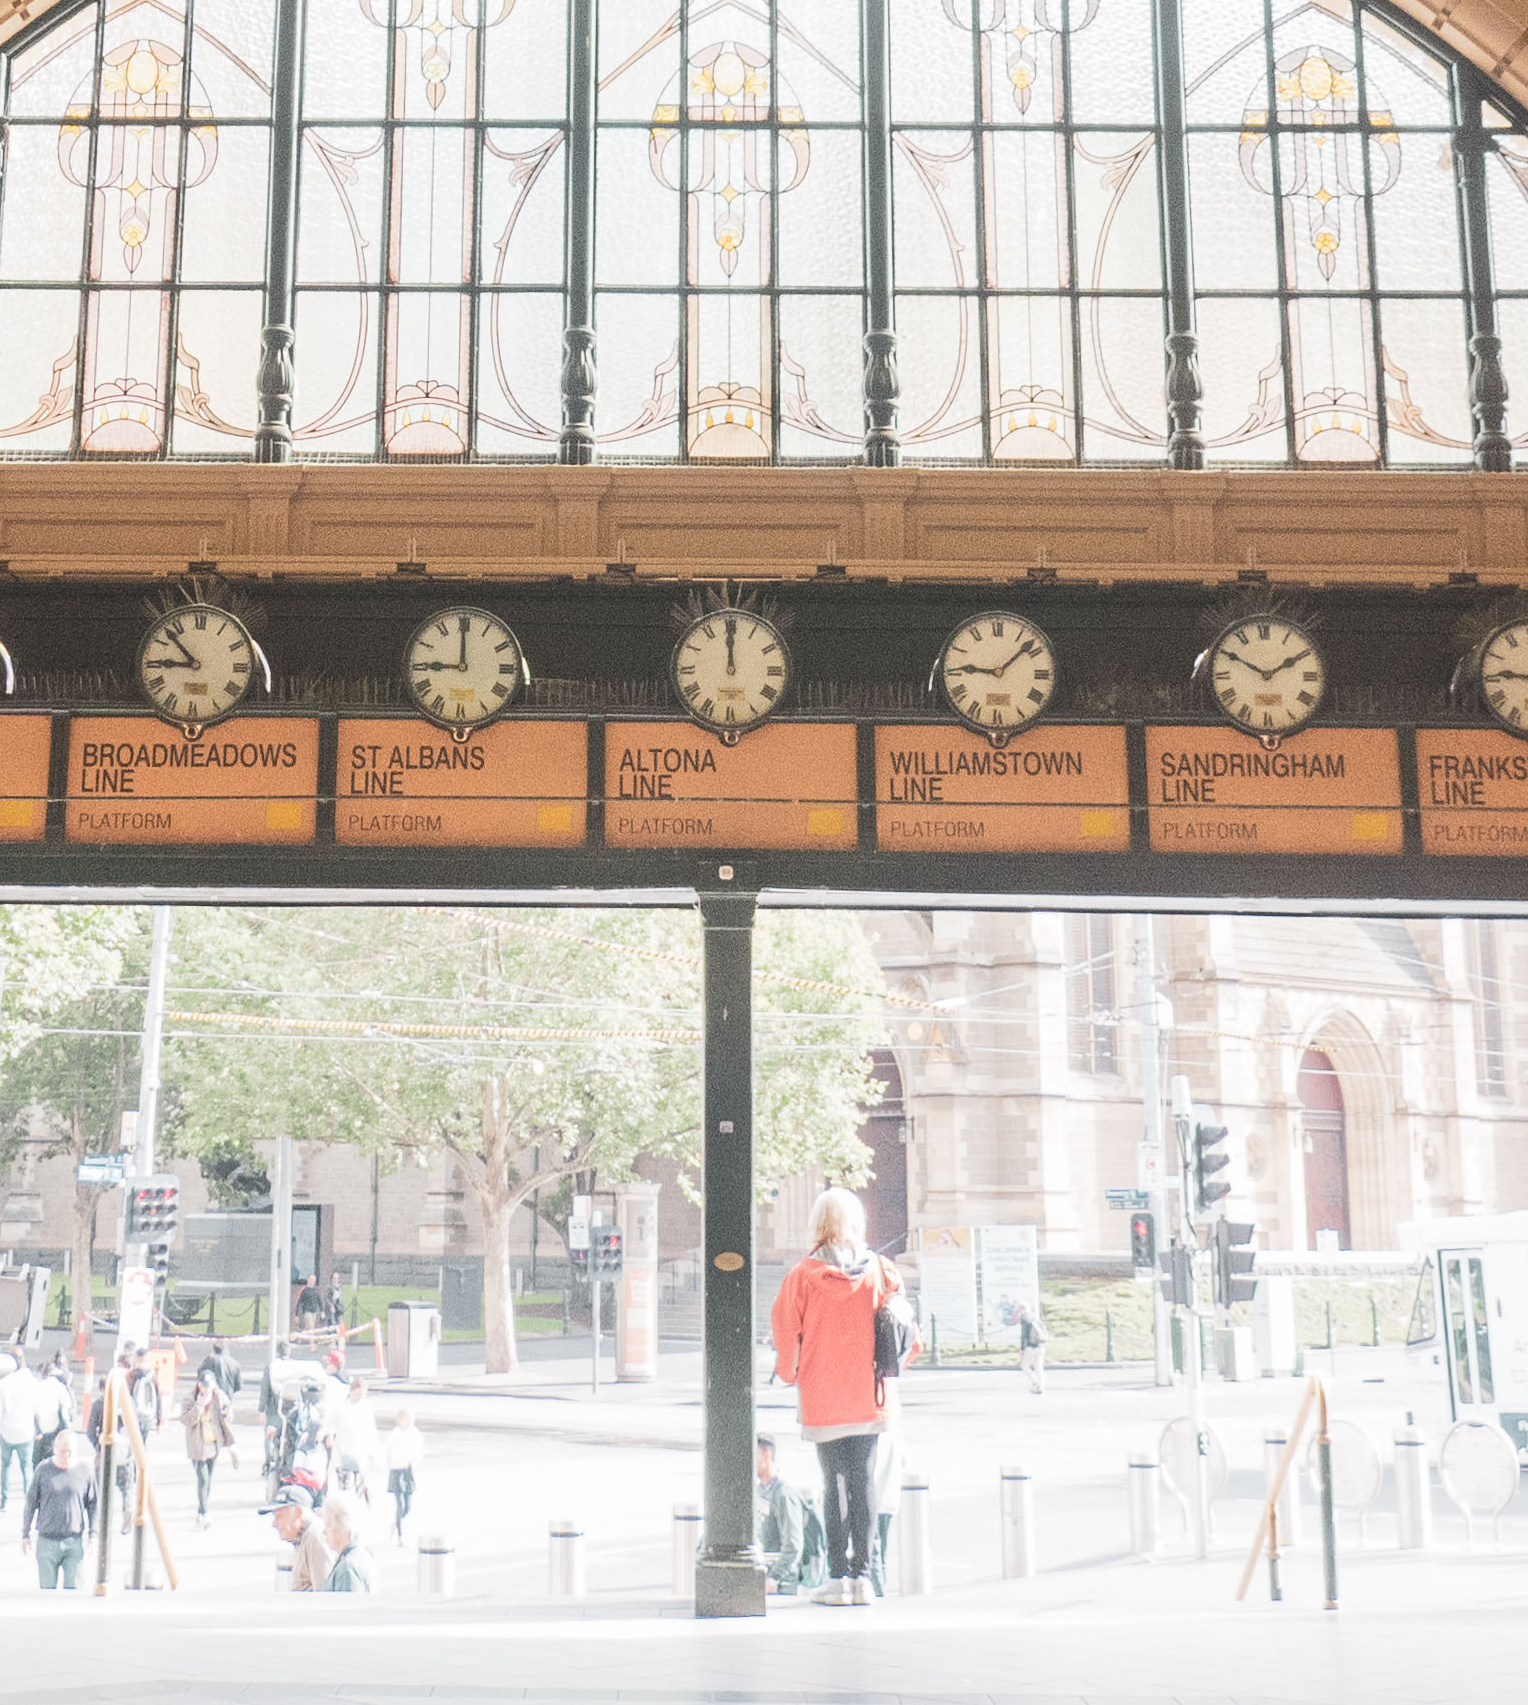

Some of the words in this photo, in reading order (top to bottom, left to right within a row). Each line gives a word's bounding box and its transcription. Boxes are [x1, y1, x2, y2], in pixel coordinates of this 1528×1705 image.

[83, 743, 297, 767] BROADMEADOWS
[351, 745, 382, 770] ST
[388, 746, 485, 770] ALBANS
[619, 748, 716, 772] ALTONA
[890, 751, 1083, 775] WILLIAMSTOWN
[1161, 752, 1345, 778] SANDRINGHAM
[81, 769, 135, 792] LINE
[350, 771, 404, 794] LINE
[619, 775, 673, 798] LINE
[890, 778, 944, 801] LINE
[1162, 778, 1216, 802] LINE
[1431, 781, 1486, 805] LINE
[78, 812, 172, 829] PLATFORM
[349, 814, 442, 831] PLATFORM
[619, 818, 713, 835] PLATFORM
[890, 821, 985, 837] PLATFORM
[1163, 822, 1257, 839] PLATFORM
[1434, 825, 1528, 841] PLATFORM
